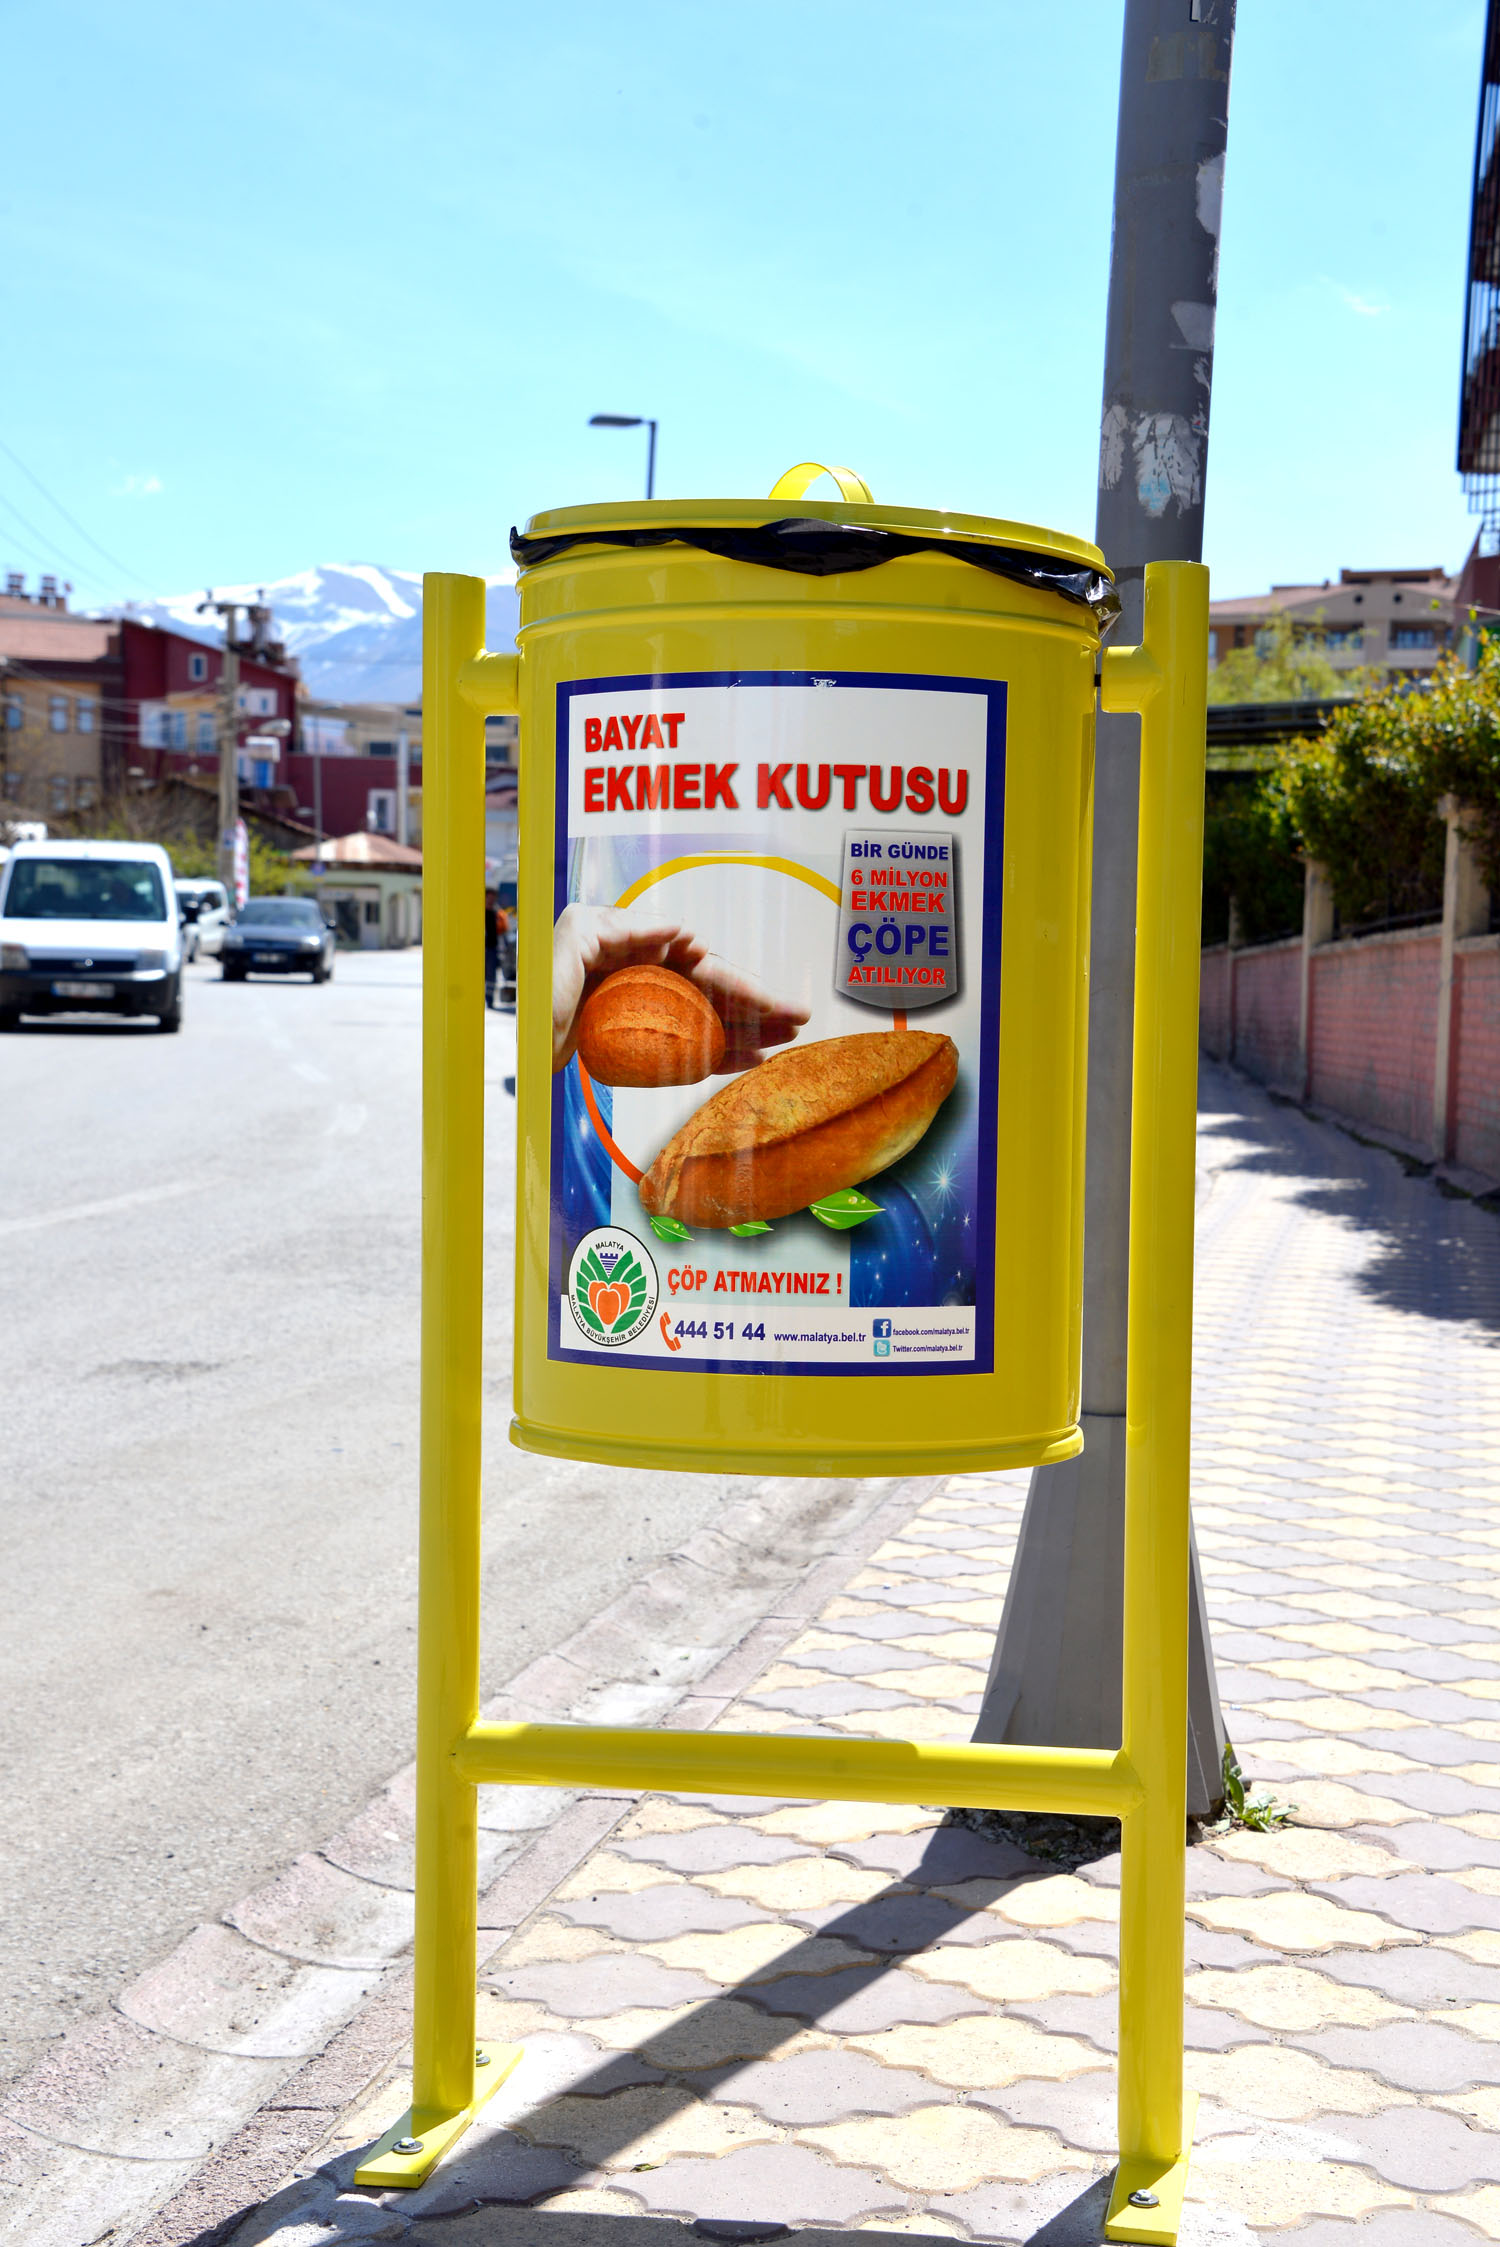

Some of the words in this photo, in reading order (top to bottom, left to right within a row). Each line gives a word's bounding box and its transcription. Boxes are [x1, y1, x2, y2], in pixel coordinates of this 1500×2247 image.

[585, 713, 686, 752] BAYAT
[584, 764, 739, 812] EKMEK
[757, 764, 968, 814] KUTUSU
[851, 840, 882, 858] BİR
[888, 842, 949, 860] GÜNDE
[851, 869, 863, 885] 6
[870, 867, 947, 888] MİLYON
[851, 891, 945, 912] EKMEK
[848, 917, 949, 963] ÇÖPE
[848, 966, 946, 985] ATILIYOR
[595, 1241, 624, 1251] MALATYA
[668, 1265, 707, 1295] ÇÖP
[714, 1271, 830, 1294] ATMAYINIZ
[571, 1294, 586, 1328] MALATYA
[586, 1327, 626, 1343] BÜYÜKŞEHİR
[675, 1320, 708, 1338] 444
[713, 1322, 734, 1339] 51
[742, 1323, 766, 1340] 44
[774, 1332, 866, 1344] www.malatya.bel.tr
[892, 1327, 970, 1336] facebook.com/malatya.bel.tr
[892, 1345, 963, 1353] Twitter.com/malatya.bel.tr
